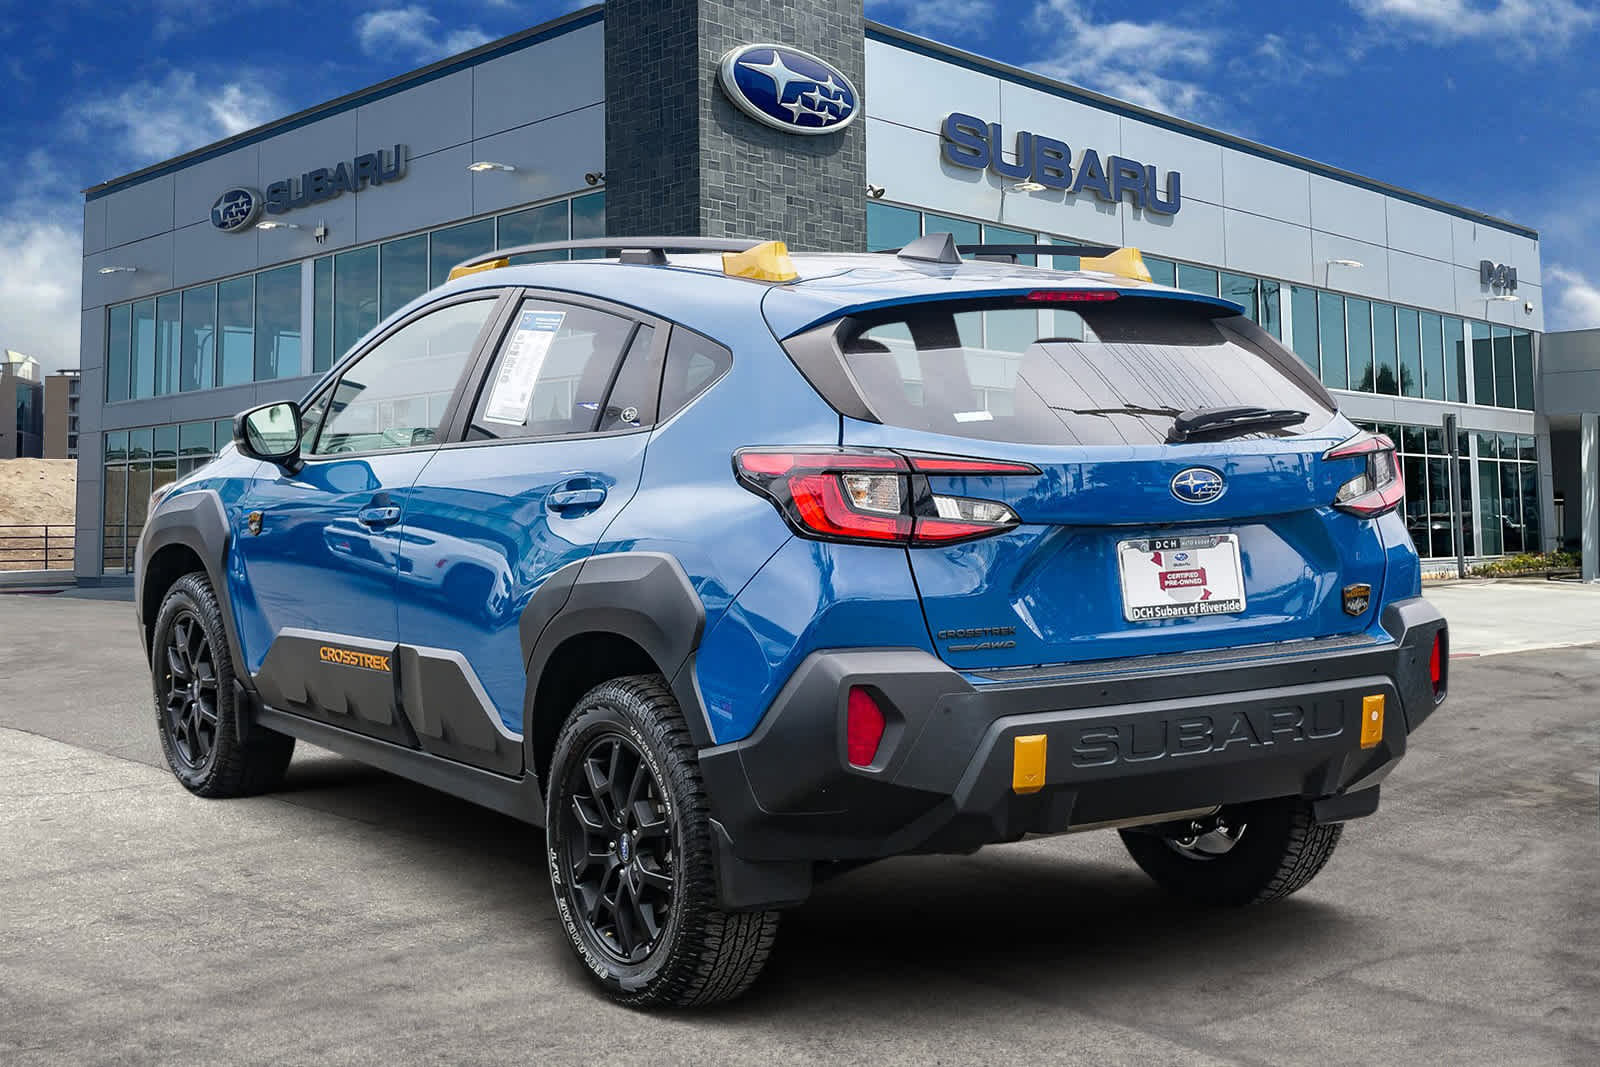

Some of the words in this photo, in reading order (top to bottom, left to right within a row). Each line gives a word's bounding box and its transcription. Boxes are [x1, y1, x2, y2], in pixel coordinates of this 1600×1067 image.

[943, 112, 1181, 215] SUBARU
[266, 144, 407, 215] SUBARU
[1155, 540, 1177, 550] DCH
[1164, 578, 1202, 586] PRE-OWNED
[1167, 571, 1199, 580] CERTIFIED
[1133, 607, 1154, 619] DCH
[1154, 605, 1188, 617] Subaru
[1188, 603, 1199, 614] of
[1200, 600, 1241, 614] Riverside
[938, 626, 1017, 640] CROSSTREK
[976, 640, 1017, 650] AWD
[320, 646, 391, 671] CROSSTREK
[1072, 699, 1345, 768] SUBARU
